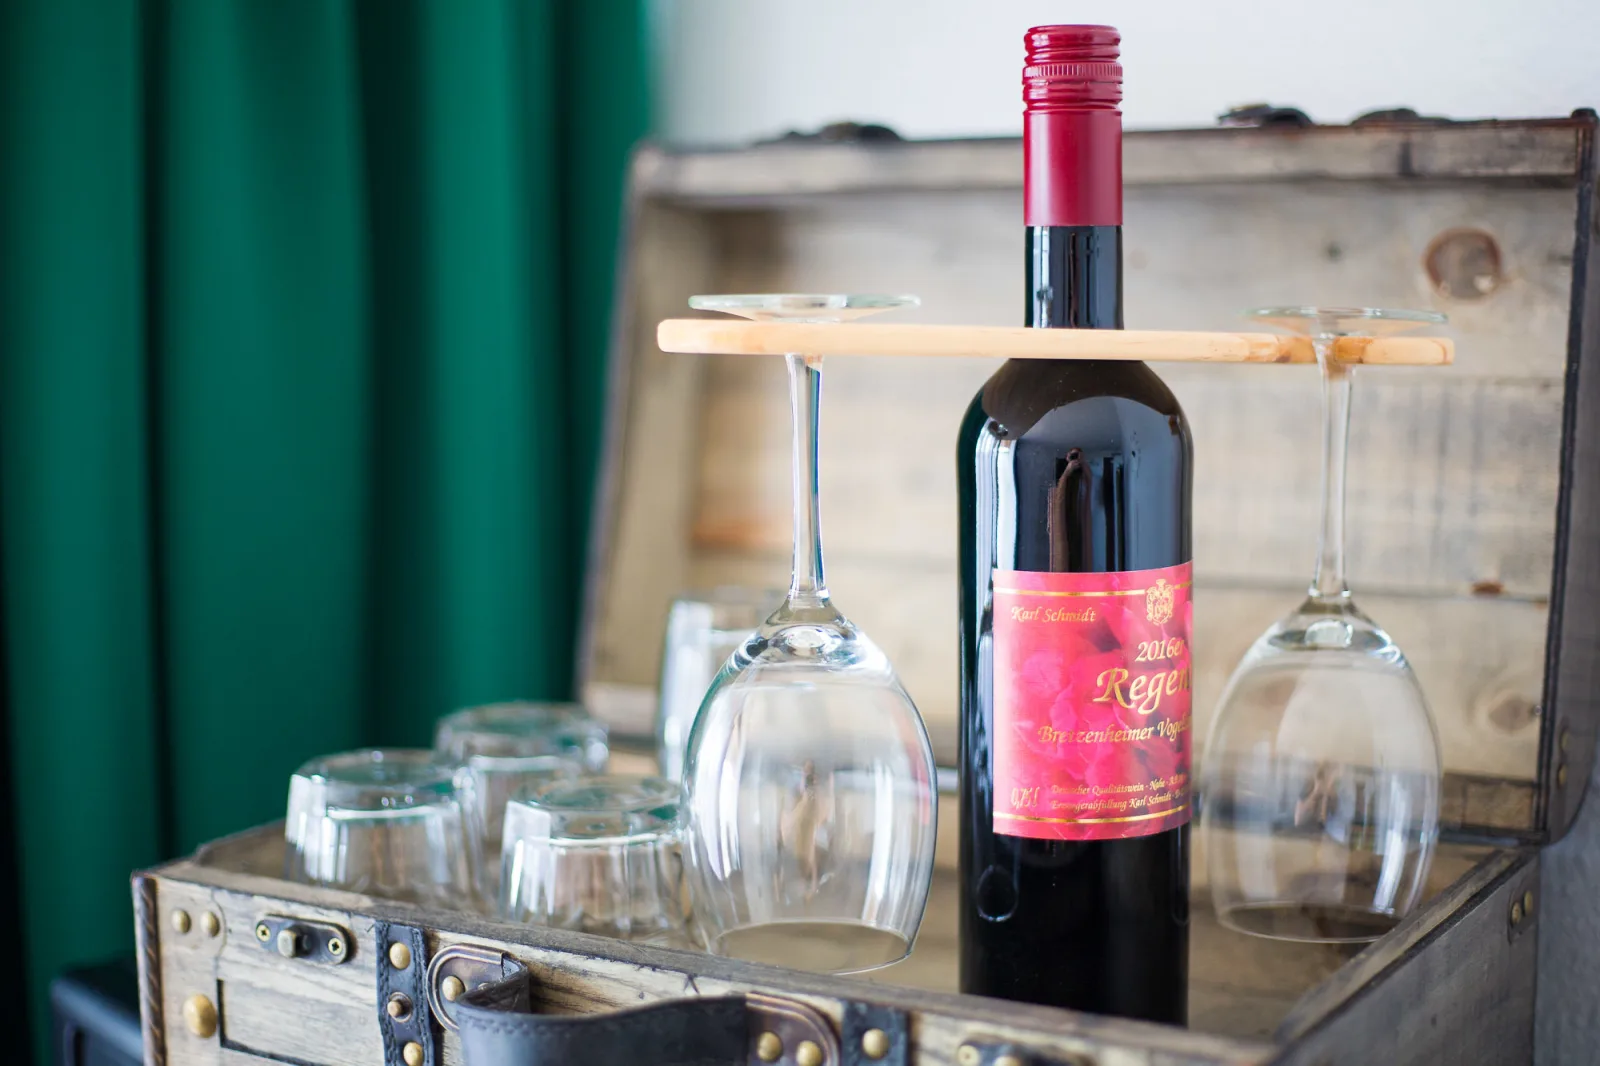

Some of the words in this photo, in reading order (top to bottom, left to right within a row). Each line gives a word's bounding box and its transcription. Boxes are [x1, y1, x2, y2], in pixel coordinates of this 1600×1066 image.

[1011, 606, 1042, 622] Karl
[1042, 607, 1096, 622] Schmidt
[1093, 667, 1191, 715] Regen
[1129, 795, 1148, 809] Karl
